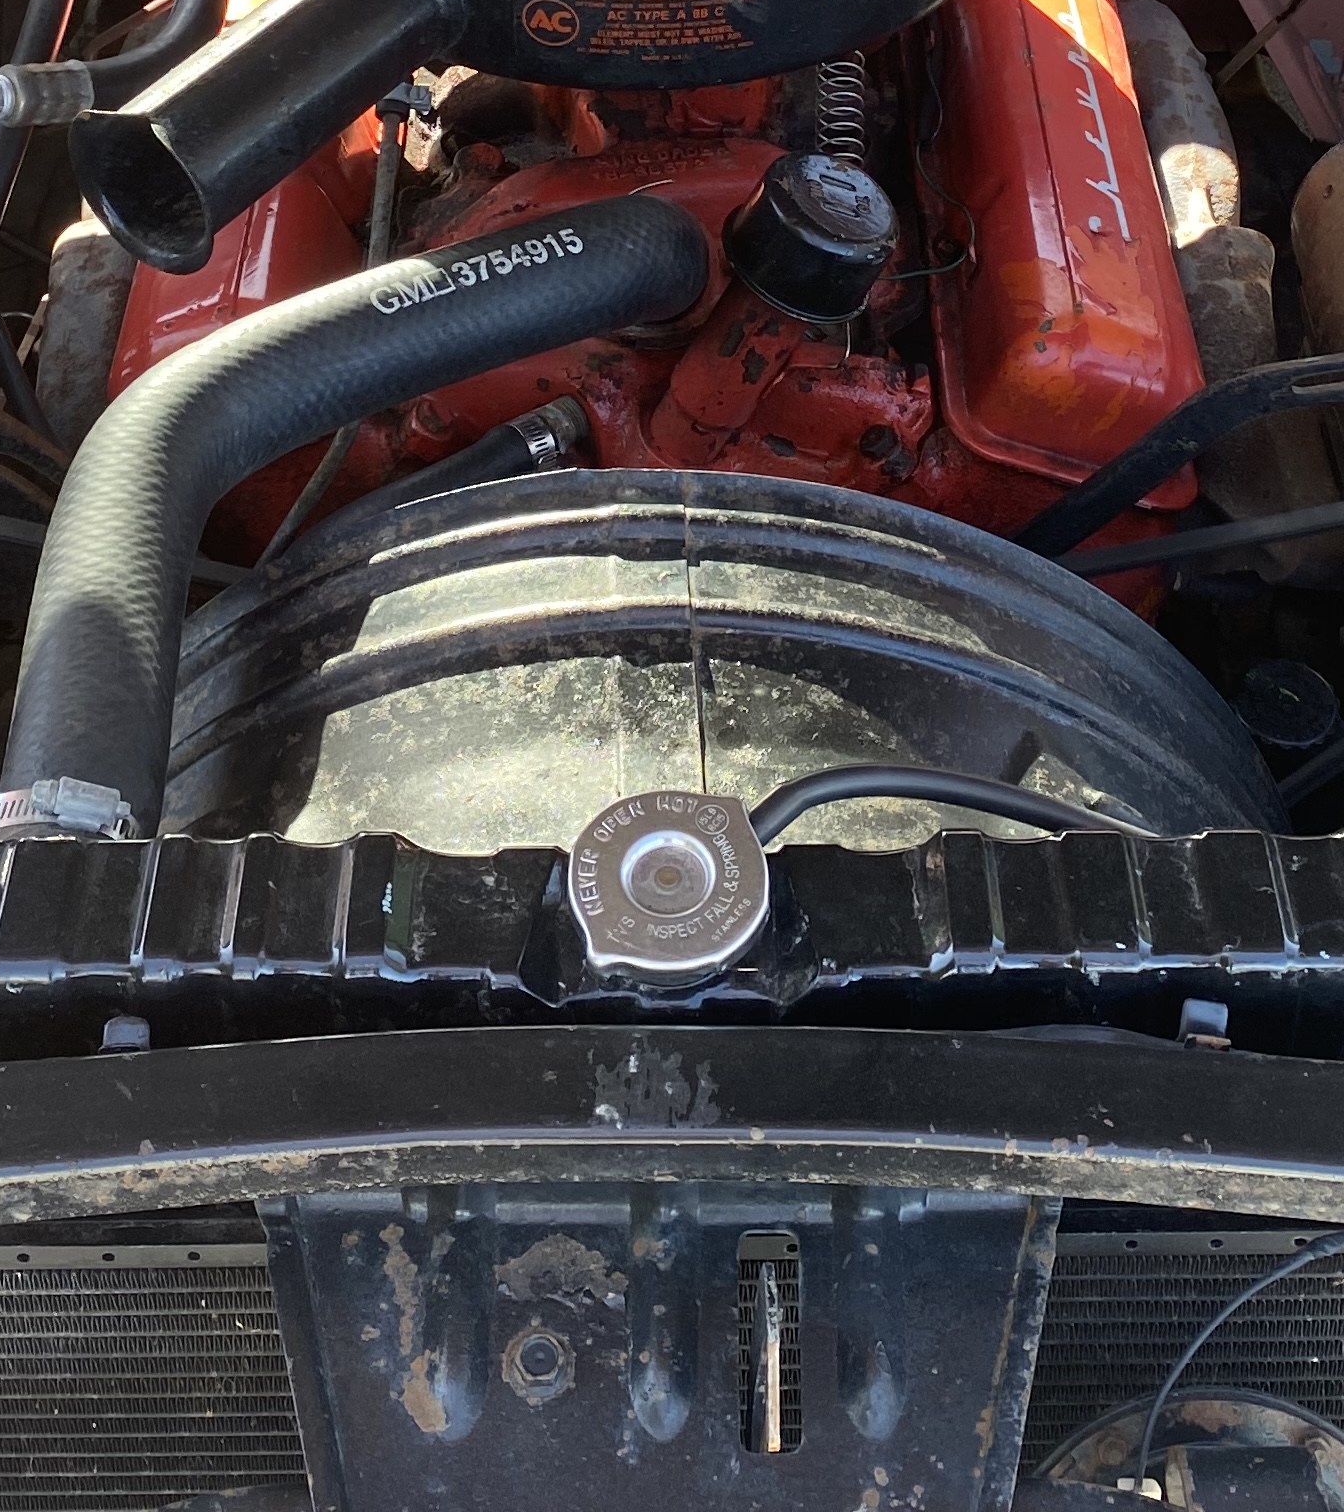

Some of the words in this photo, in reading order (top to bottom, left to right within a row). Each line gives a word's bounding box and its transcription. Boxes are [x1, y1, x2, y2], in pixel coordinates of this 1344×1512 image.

[529, 8, 573, 34] AC
[606, 10, 627, 21] AC
[633, 10, 670, 21] TYPE
[676, 9, 687, 20] A
[451, 228, 584, 287] 3754915
[577, 848, 605, 917] NEVER
[593, 799, 646, 842] OPEN
[656, 794, 699, 814] HOT
[712, 833, 740, 879] SPRING
[723, 880, 740, 892] &
[703, 894, 735, 923] FALL
[711, 898, 752, 943] STAINLESS
[646, 916, 705, 939] INSPECT
